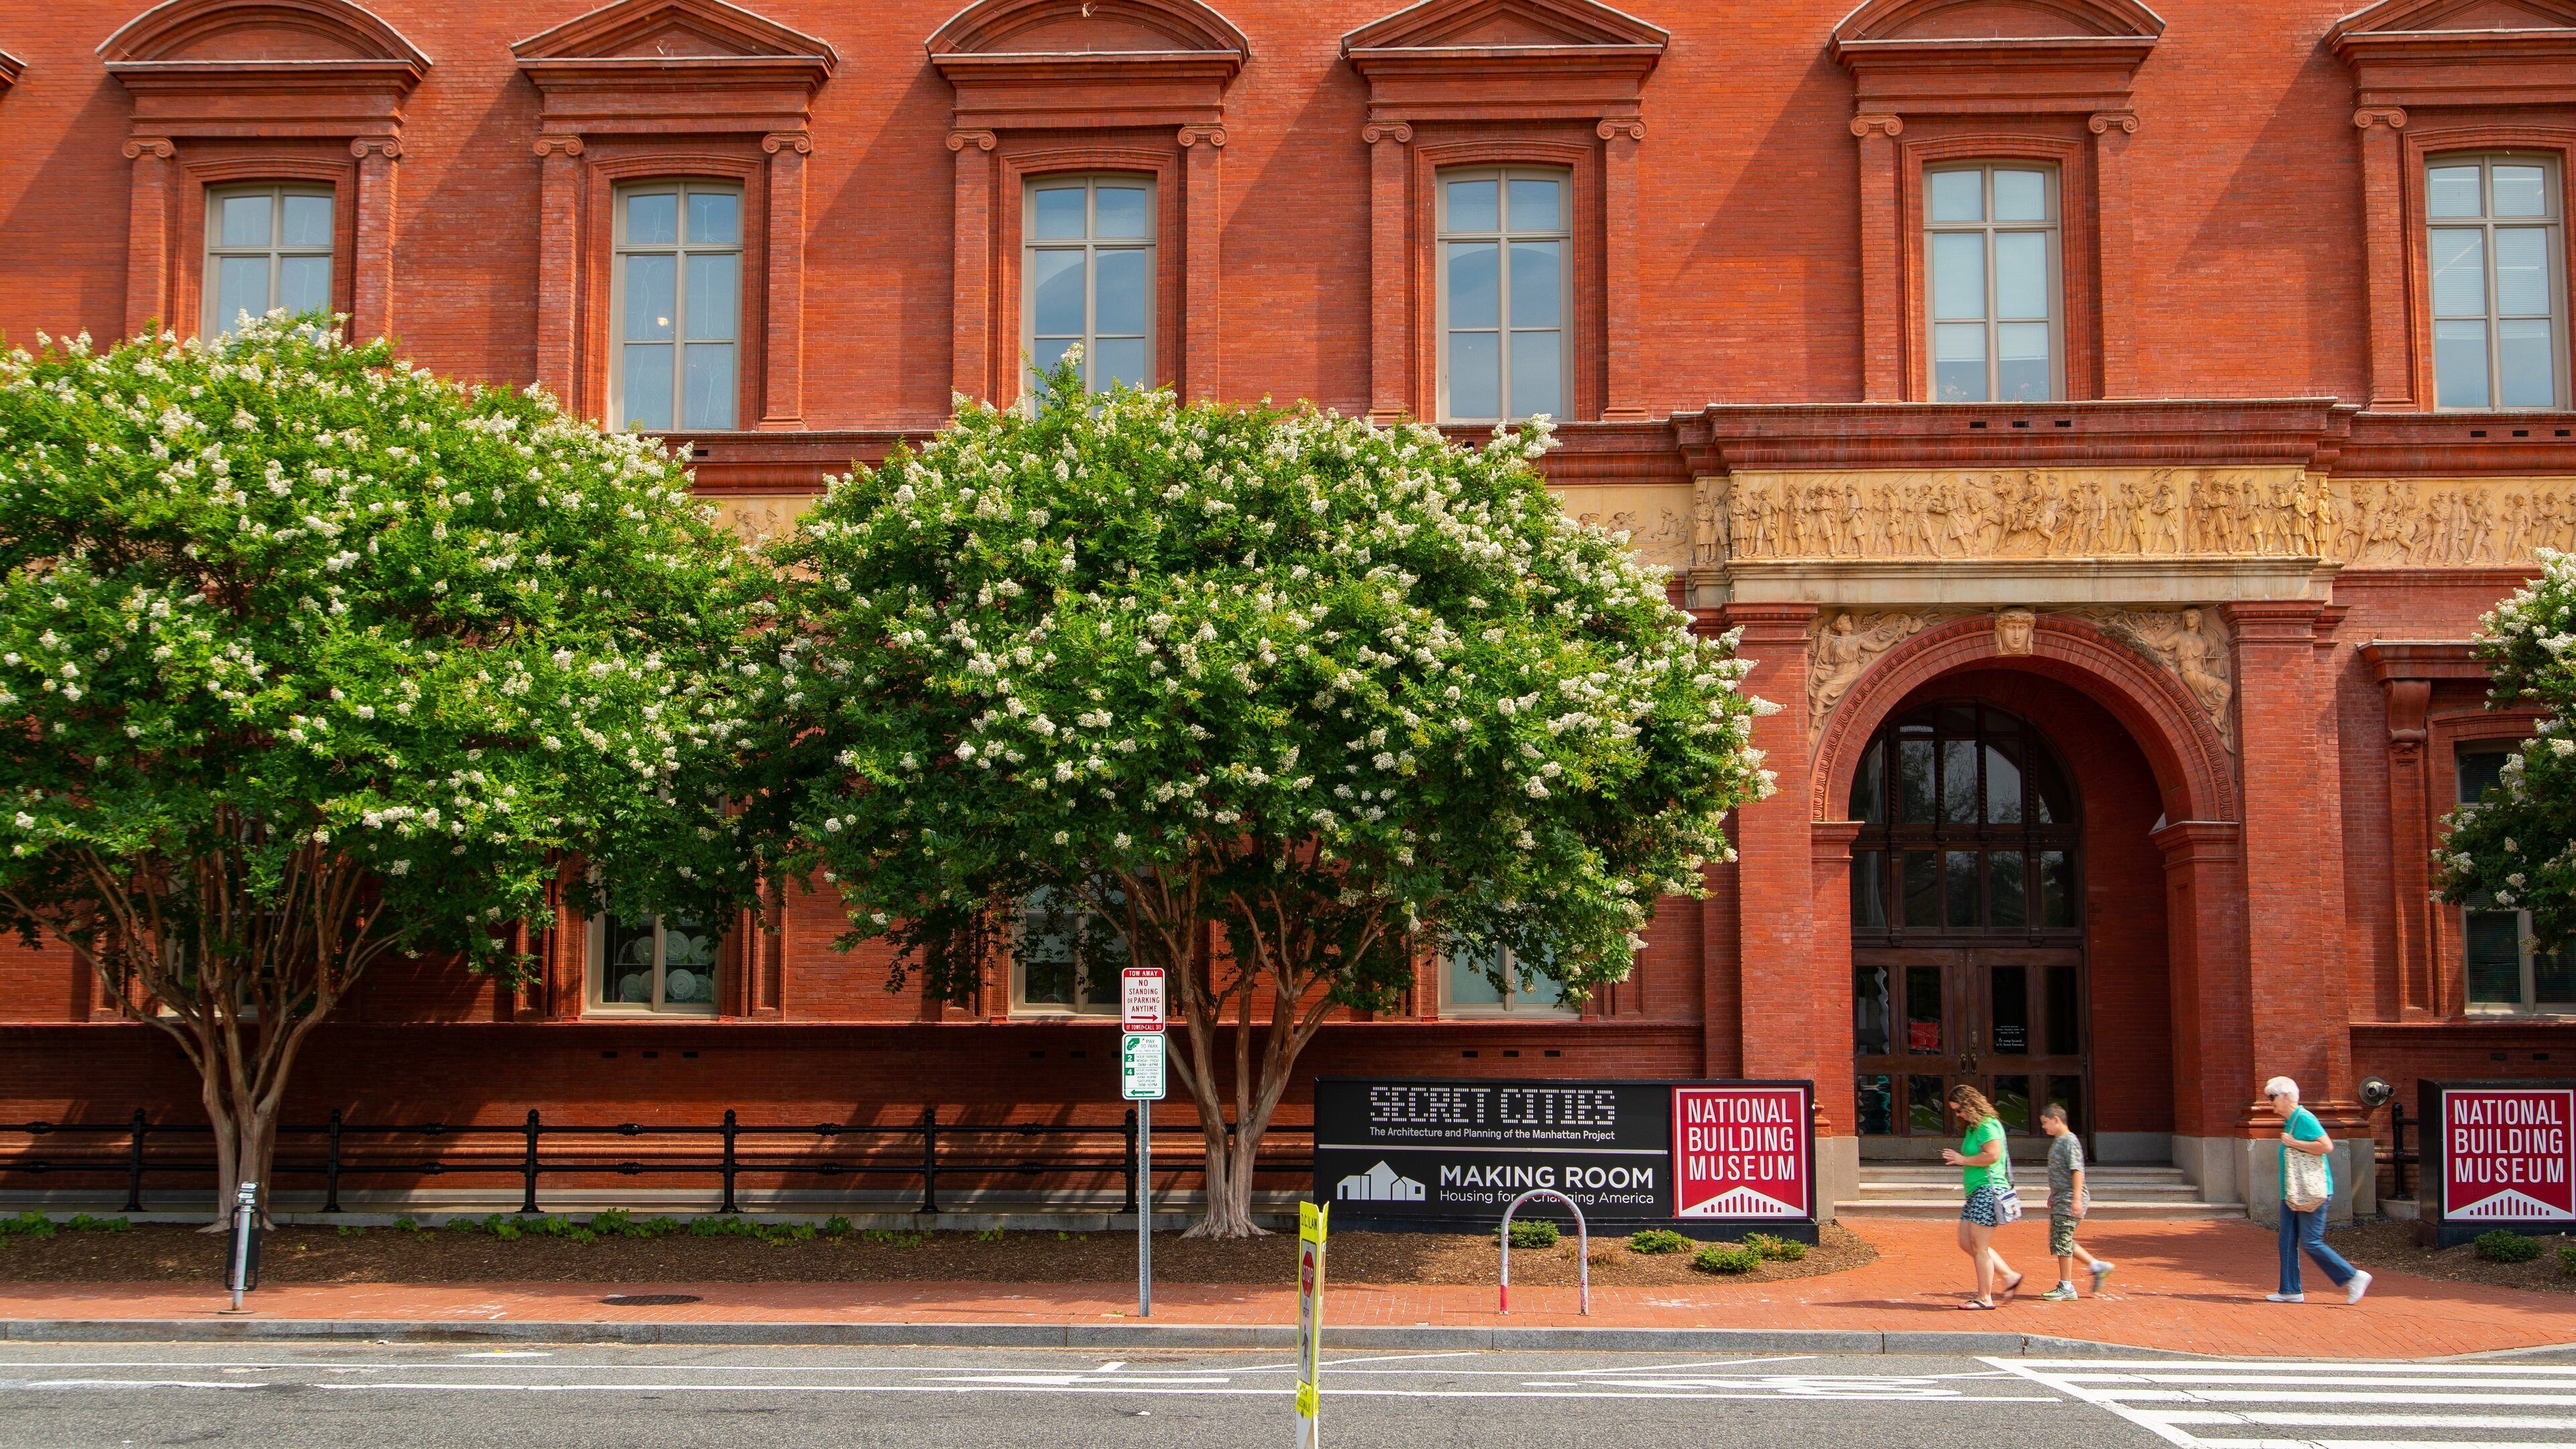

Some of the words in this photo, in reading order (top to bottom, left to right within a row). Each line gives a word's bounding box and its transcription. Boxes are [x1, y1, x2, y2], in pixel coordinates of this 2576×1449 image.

[1371, 1087, 1491, 1123] SECRET
[1501, 1088, 1615, 1126] CITIES
[1688, 1098, 1793, 1124] NATIONAL
[2454, 1099, 2563, 1125] NATIONAL
[1370, 1127, 1386, 1136] The
[1388, 1128, 1443, 1137] Architecture
[1445, 1128, 1461, 1137] and
[1464, 1128, 1501, 1140] Planning
[1504, 1130, 1513, 1138] of
[1515, 1130, 1530, 1138] the
[1533, 1130, 1581, 1139] Manhattan
[1583, 1130, 1615, 1141] Project
[1688, 1126, 1794, 1152] BUILDING
[2455, 1128, 2563, 1154] BUILDING
[1440, 1165, 1555, 1187] MAKING
[1566, 1167, 1653, 1189] ROOM
[1689, 1155, 1795, 1181] MUSEUM
[2455, 1157, 2564, 1183] MUSEUM
[1440, 1190, 1493, 1203] Housing
[1505, 1191, 1517, 1201] for
[1599, 1192, 1654, 1203] America
[1308, 1216, 1318, 1230] LAW
[1303, 1265, 1313, 1284] STOP
